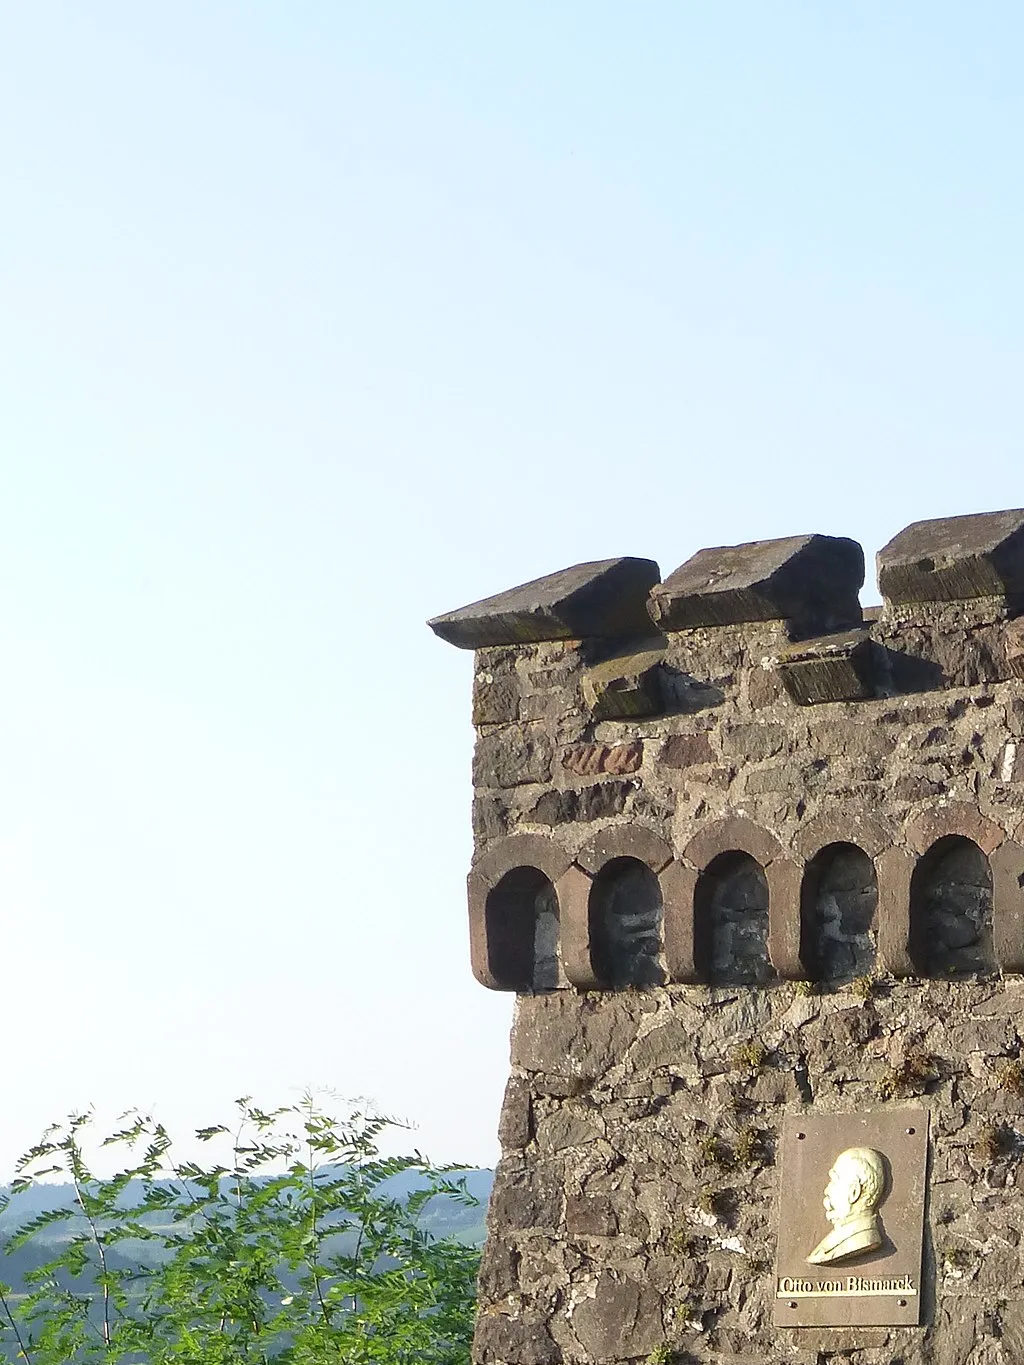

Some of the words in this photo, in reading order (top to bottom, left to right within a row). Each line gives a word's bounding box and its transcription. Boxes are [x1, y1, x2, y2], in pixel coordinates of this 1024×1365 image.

[780, 1277, 813, 1292] Otto
[817, 1280, 842, 1291] von
[846, 1275, 913, 1290] Bismarck
